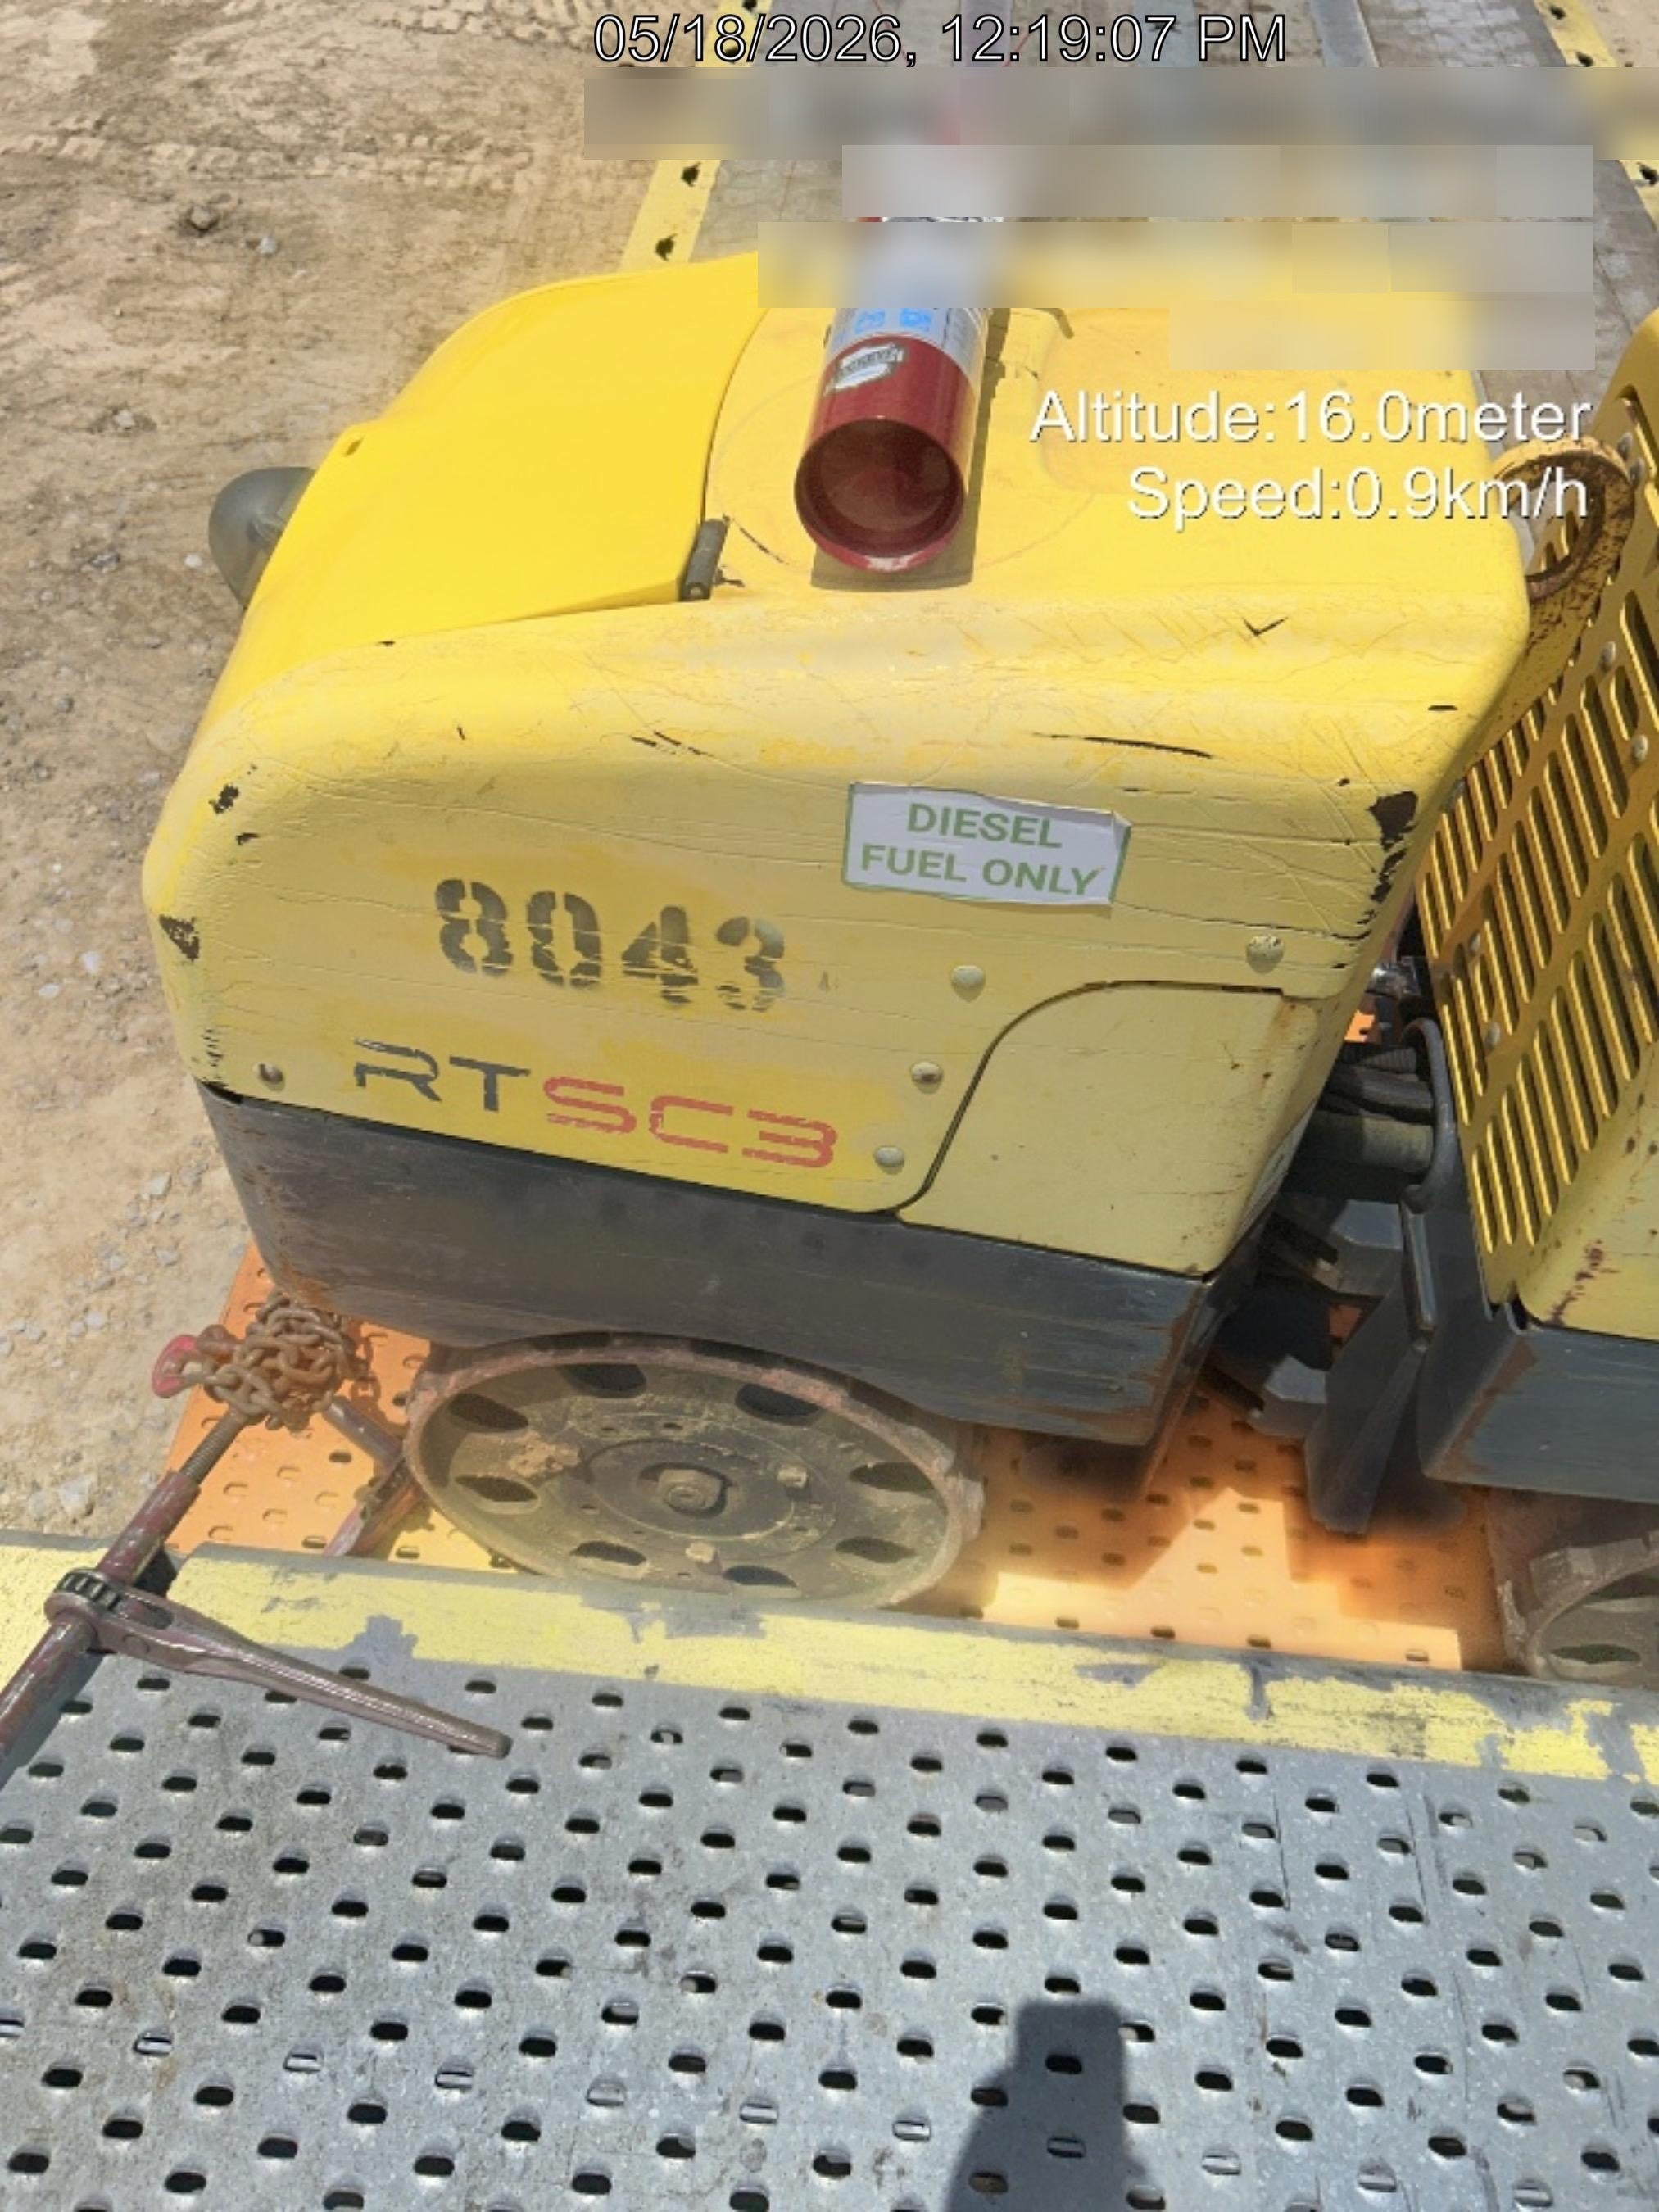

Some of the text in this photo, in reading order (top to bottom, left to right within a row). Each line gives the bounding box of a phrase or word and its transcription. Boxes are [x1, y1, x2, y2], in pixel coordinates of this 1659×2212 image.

[907, 803, 1063, 849] DIESEL
[861, 843, 1104, 896] FUEL ONLY
[435, 878, 786, 1011] 8043
